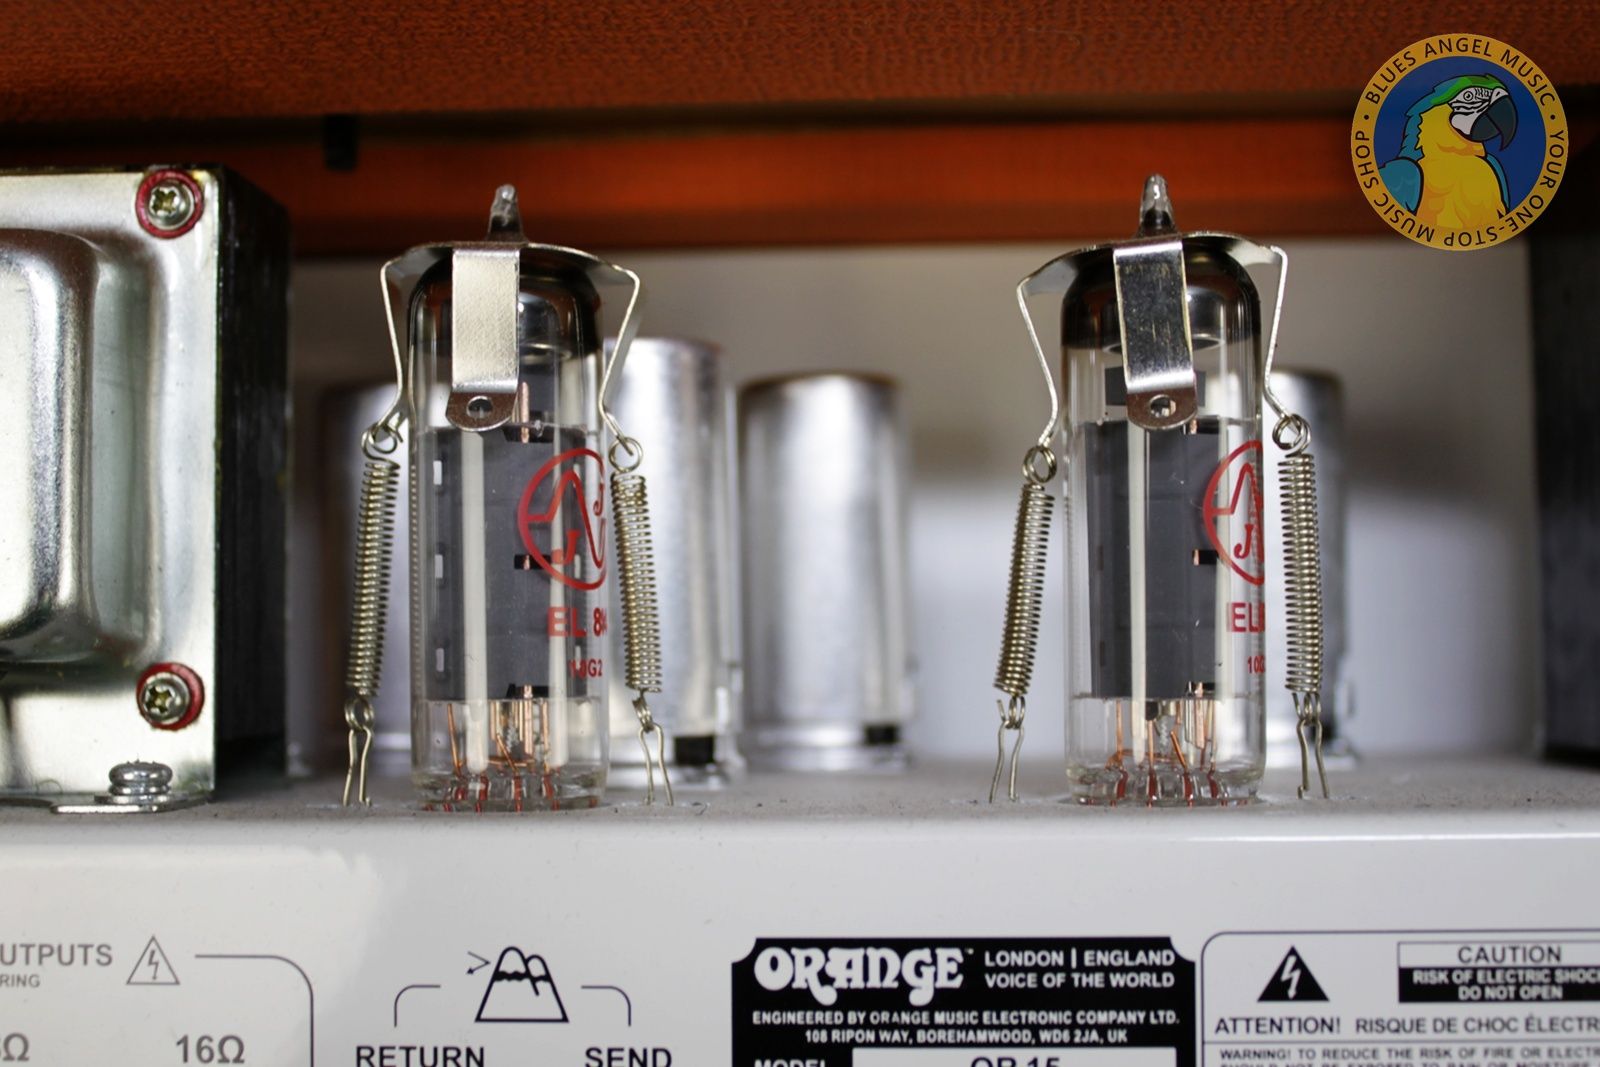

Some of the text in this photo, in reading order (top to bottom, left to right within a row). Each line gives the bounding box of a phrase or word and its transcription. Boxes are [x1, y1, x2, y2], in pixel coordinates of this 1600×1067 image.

[548, 608, 587, 637] EL
[984, 950, 1175, 967] LONDON ENGLAND
[1458, 946, 1562, 964] CAUTION
[754, 947, 964, 1006] ORANGE
[985, 972, 1175, 988] VOICE OF THE WORLD
[1413, 968, 1600, 985] RISK OF ELECTRIC SHOC
[1458, 985, 1563, 1000] DO NOT OPEN
[752, 1010, 1180, 1025] ENGINEERED BY ORANGE MUSIC ELECTRONIC COMPANY LTD.
[1215, 1017, 1341, 1035] ATTENTION!
[1355, 1017, 1426, 1035] RISQUE
[1433, 1016, 1457, 1033] DE
[1463, 1016, 1519, 1033] CHOC
[831, 1030, 876, 1044] RIPON
[879, 1030, 913, 1045] WAY,
[916, 1029, 1036, 1045] BOREHAMWOOD,
[1038, 1029, 1071, 1043] WD6
[1107, 1029, 1128, 1043] UK
[176, 1034, 245, 1064] 16Ω
[356, 1046, 485, 1067] RETURN
[585, 1047, 673, 1067] SEND
[1220, 1048, 1292, 1060] WARNING!
[1298, 1048, 1316, 1060] TO
[1322, 1048, 1379, 1060] REDUCE
[1386, 1048, 1412, 1060] THE
[1420, 1047, 1451, 1059] RISK
[1458, 1047, 1475, 1059] OF
[1483, 1047, 1511, 1059] FIRE
[1520, 1047, 1540, 1059] OR
